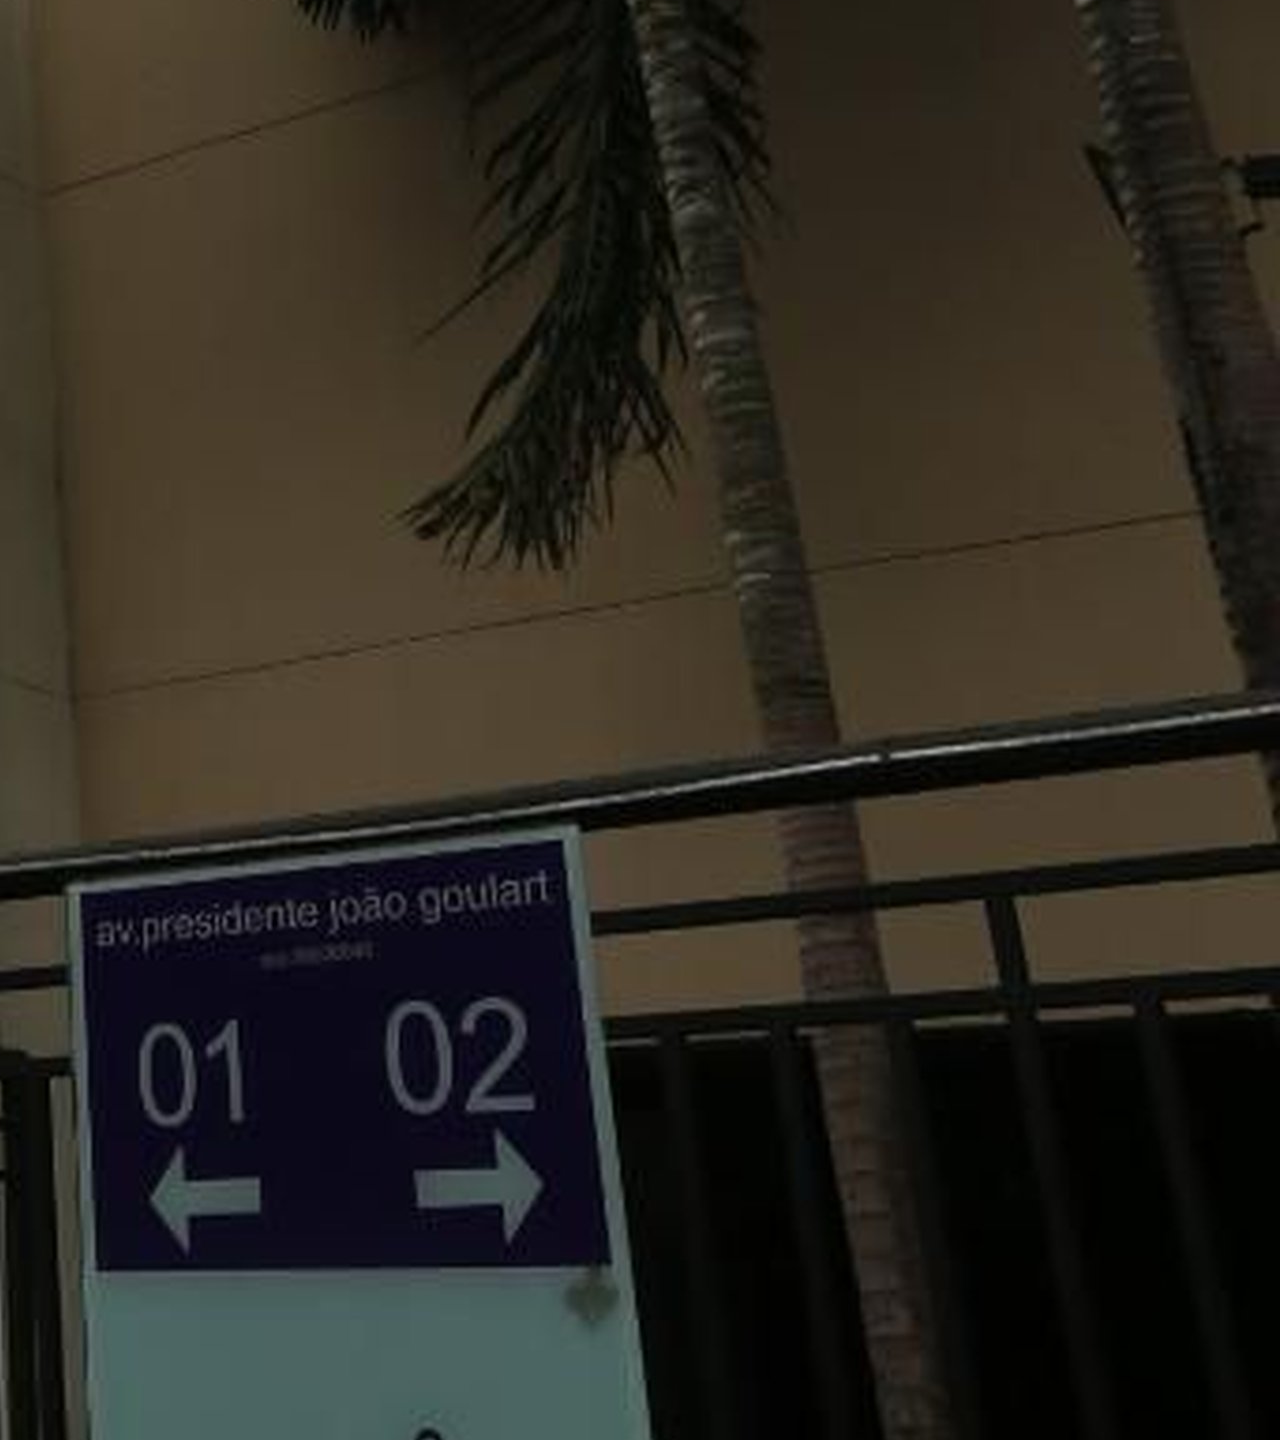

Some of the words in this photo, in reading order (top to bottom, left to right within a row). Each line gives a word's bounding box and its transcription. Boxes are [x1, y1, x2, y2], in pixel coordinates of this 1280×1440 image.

[94, 897, 320, 953] av.presidente
[328, 885, 408, 934] joão
[415, 868, 551, 925] goulart
[139, 1017, 246, 1127] 01
[384, 994, 536, 1116] 02
